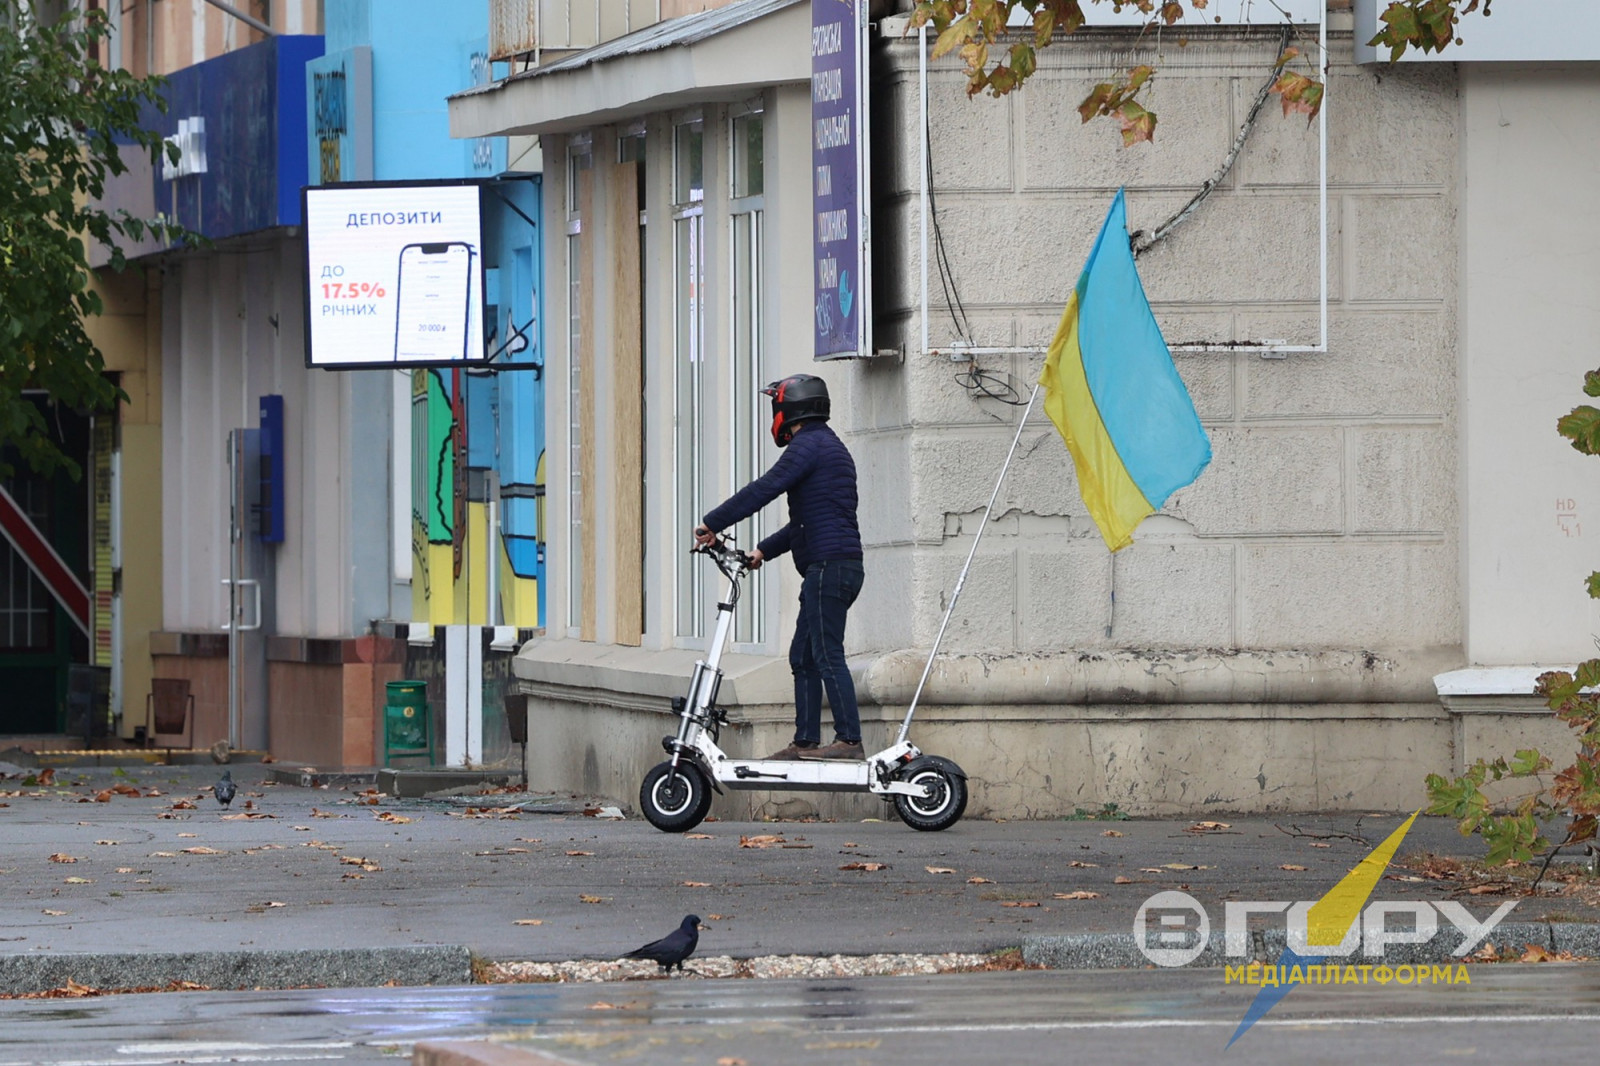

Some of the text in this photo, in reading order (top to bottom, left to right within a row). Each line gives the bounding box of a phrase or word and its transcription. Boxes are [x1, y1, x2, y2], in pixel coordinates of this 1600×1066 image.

[812, 21, 842, 57] ЕРСОНСЬКА
[346, 211, 442, 228] ДЕПОЗИТИ
[321, 265, 345, 279] ДО
[321, 282, 386, 299] 17.5%
[322, 304, 377, 316] РІЧНИХ
[1556, 498, 1576, 511] HD
